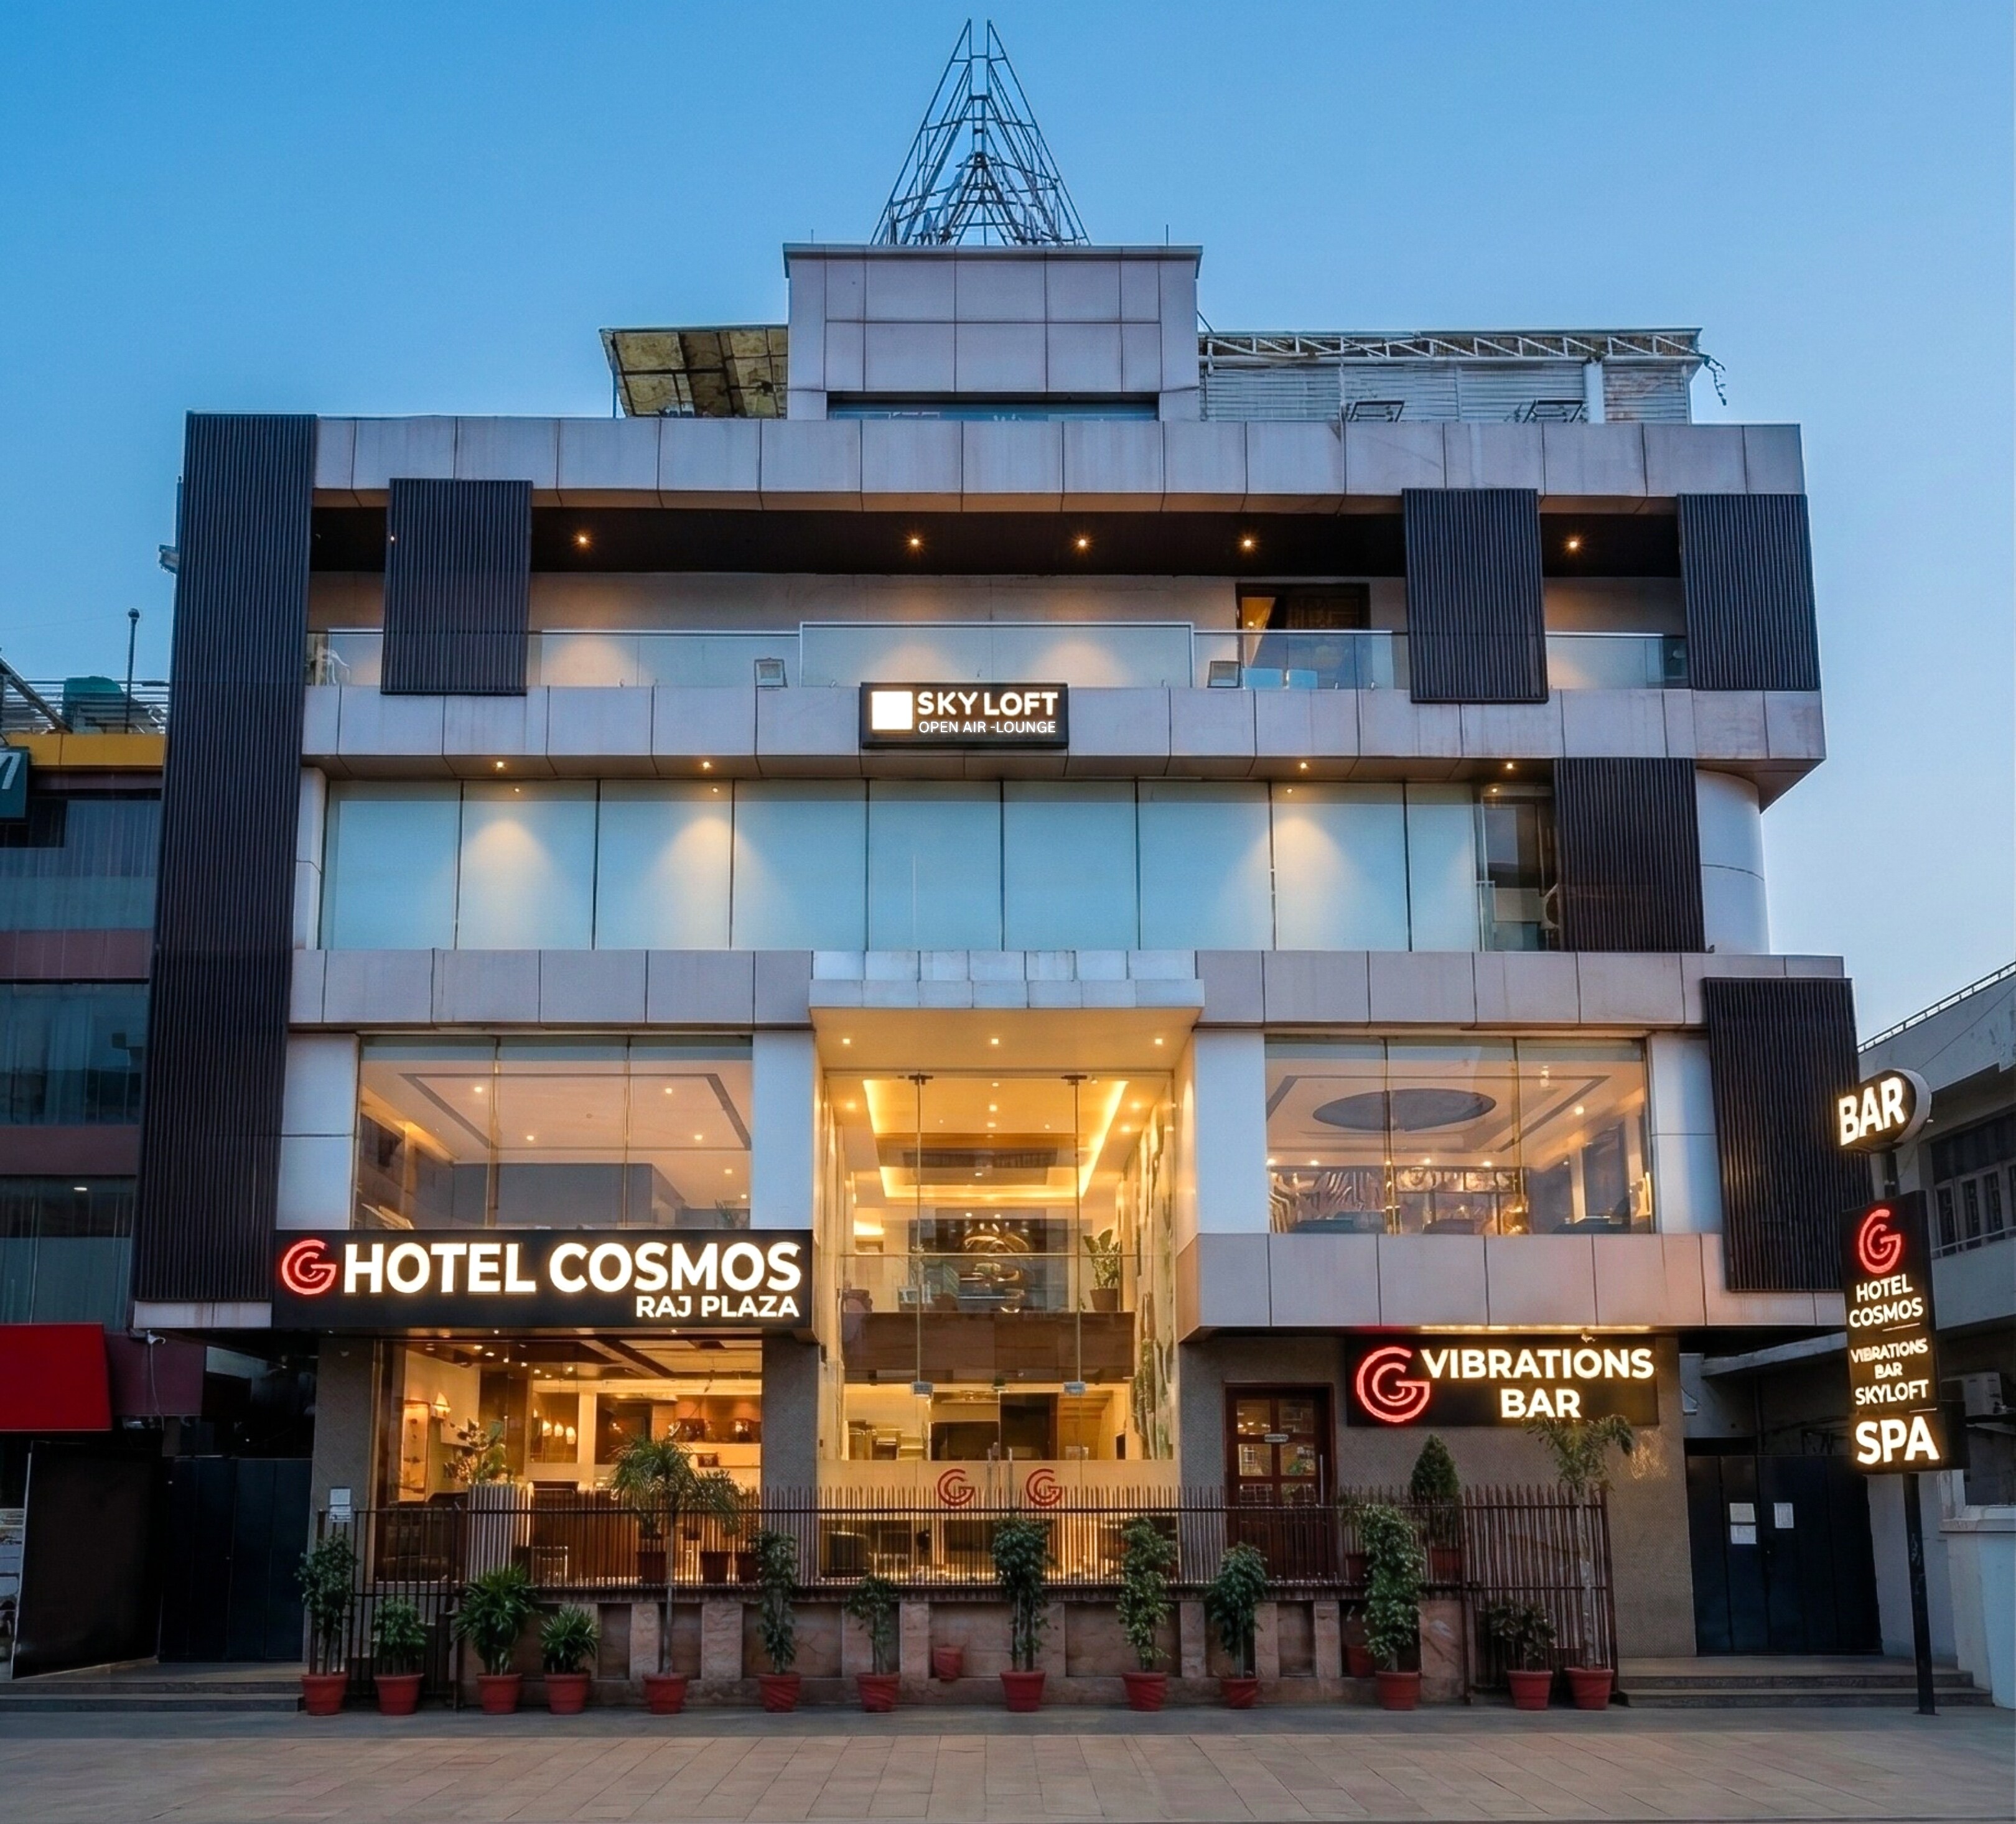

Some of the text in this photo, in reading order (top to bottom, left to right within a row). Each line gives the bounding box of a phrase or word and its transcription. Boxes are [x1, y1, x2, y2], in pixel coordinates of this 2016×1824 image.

[918, 721, 959, 733] OPEN
[962, 721, 987, 733] AIR
[1839, 1076, 1905, 1146] BAR
[344, 1242, 536, 1293] HOTEL
[549, 1242, 801, 1293] COSMOS
[1856, 1273, 1913, 1303] HOTEL
[636, 1295, 800, 1318] RAJ PLAZA
[1849, 1297, 1924, 1328] COSMOS
[1421, 1348, 1654, 1379] VIBRATIONS
[1850, 1338, 1928, 1363] VIBRATIONS
[1875, 1362, 1903, 1379] BAR
[1501, 1388, 1581, 1418] BAR
[1855, 1379, 1929, 1405] SKYLOFT
[1855, 1416, 1940, 1464] SPA
